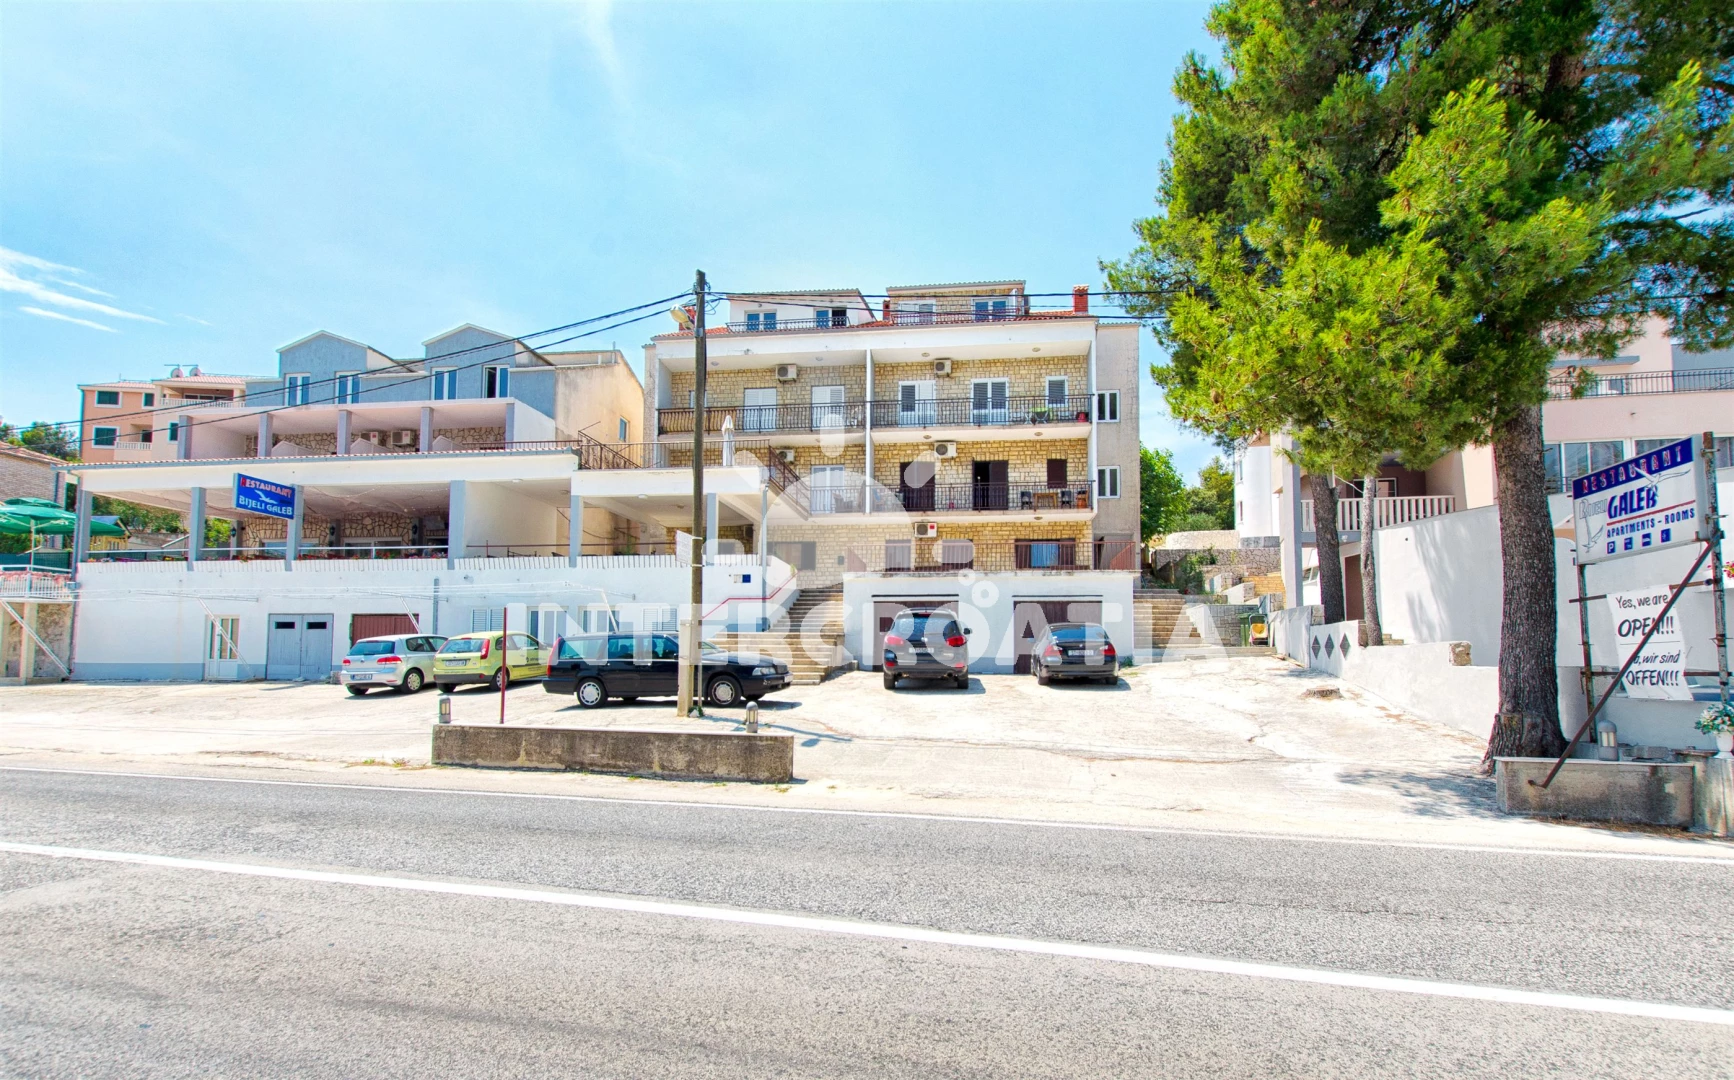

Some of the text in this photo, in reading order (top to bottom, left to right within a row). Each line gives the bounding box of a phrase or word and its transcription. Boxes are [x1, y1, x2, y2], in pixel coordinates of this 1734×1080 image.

[1582, 446, 1682, 494] RESTAURANT
[241, 477, 292, 498] RESTAURANT
[239, 495, 293, 515] BIJELI GALEB
[1607, 484, 1658, 519] GALEB
[1607, 518, 1655, 538] APARTMENTS
[1664, 508, 1695, 525] ROOMS
[1615, 594, 1669, 609] Yes, we are
[1642, 652, 1659, 664] wir
[1660, 649, 1681, 664] sind
[1625, 670, 1680, 687] OFFEN!!!
